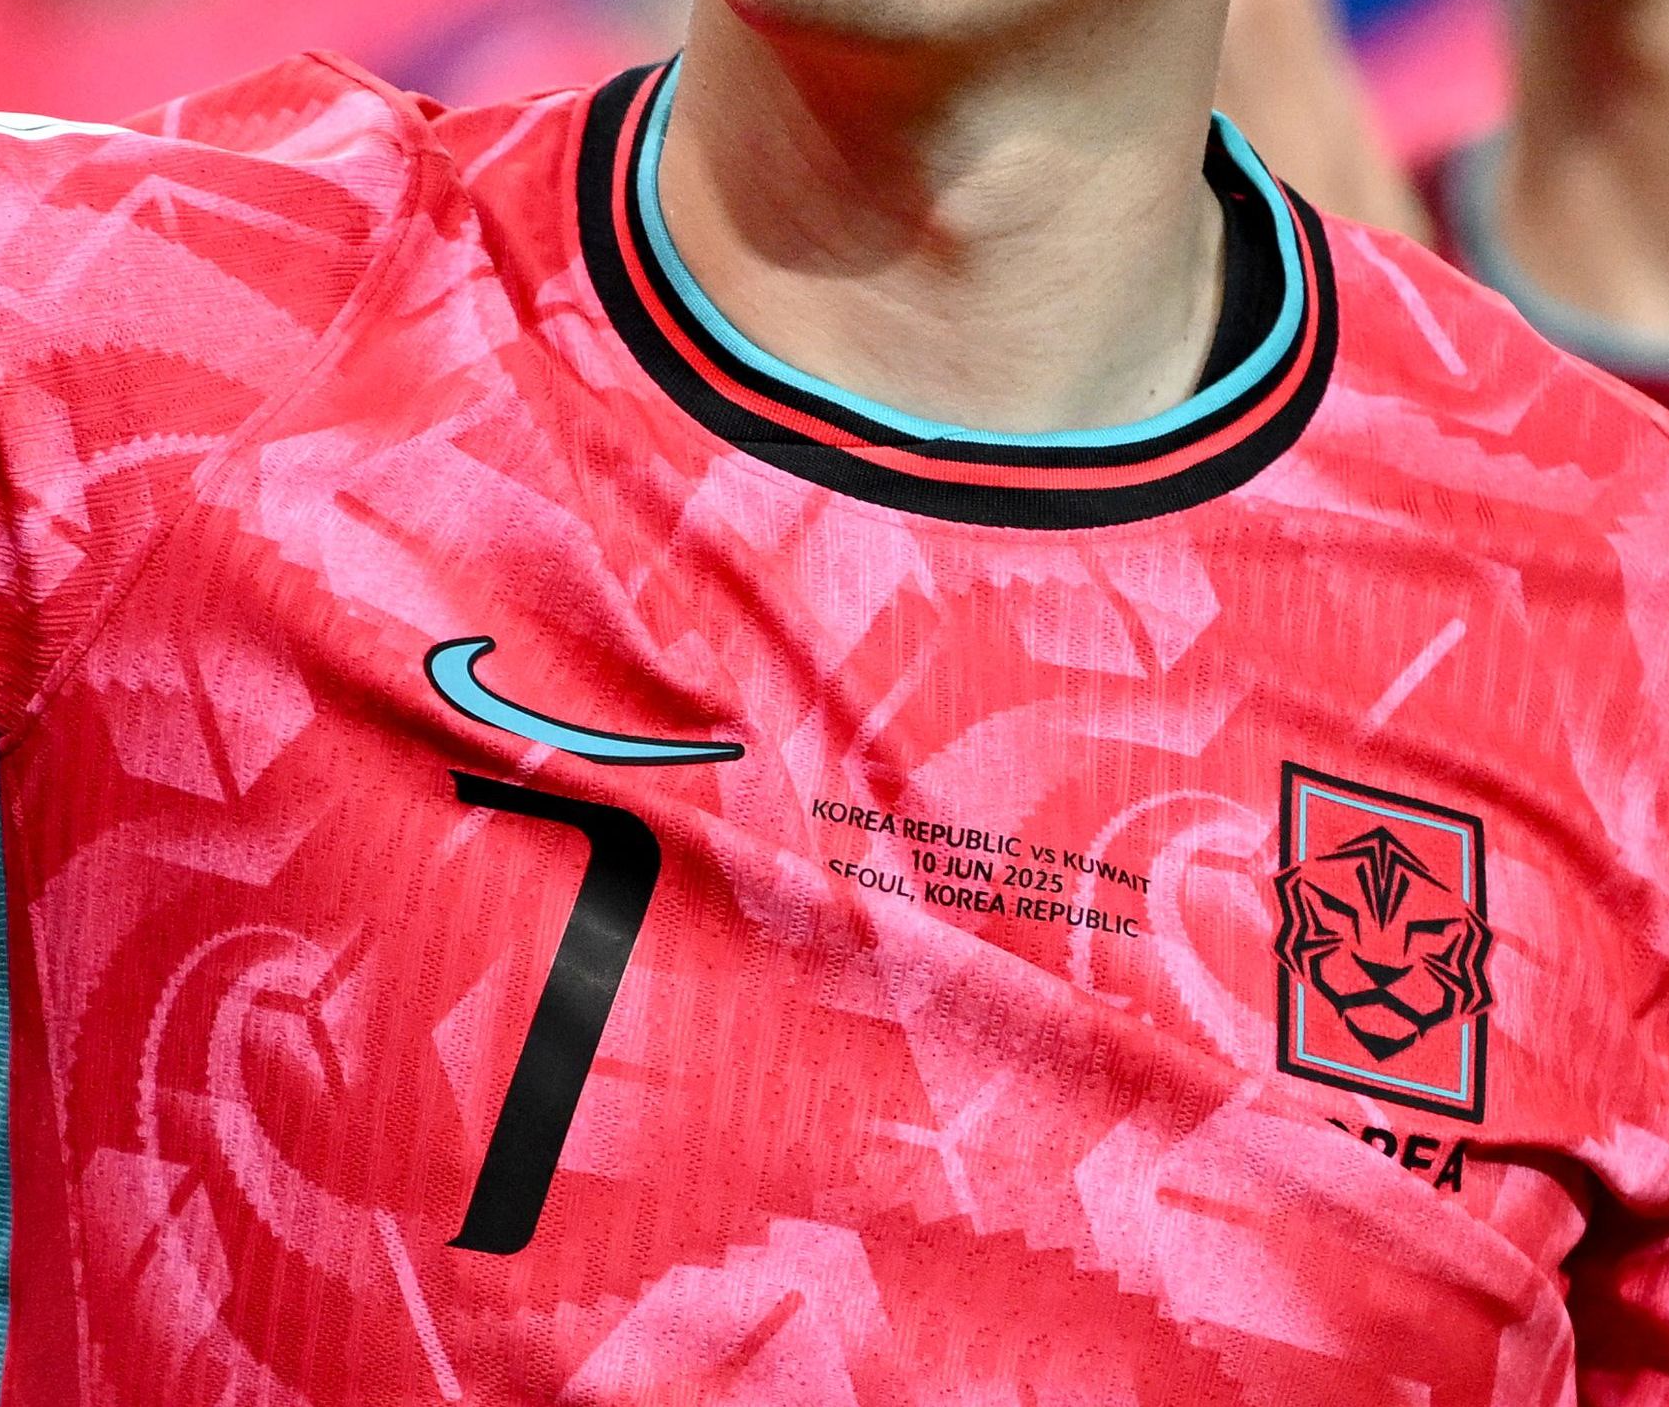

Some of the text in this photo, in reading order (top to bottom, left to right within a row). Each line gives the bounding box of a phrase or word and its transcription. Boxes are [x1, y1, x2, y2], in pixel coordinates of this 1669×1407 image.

[812, 799, 896, 835] KOREA
[902, 818, 1022, 858] REPUBLIC
[1063, 850, 1151, 894] KUWAIT
[912, 849, 1064, 893] 10 JUN 2025
[924, 881, 1006, 916] KOREA
[1016, 897, 1140, 938] REPUBLIC
[444, 769, 661, 1255] 7
